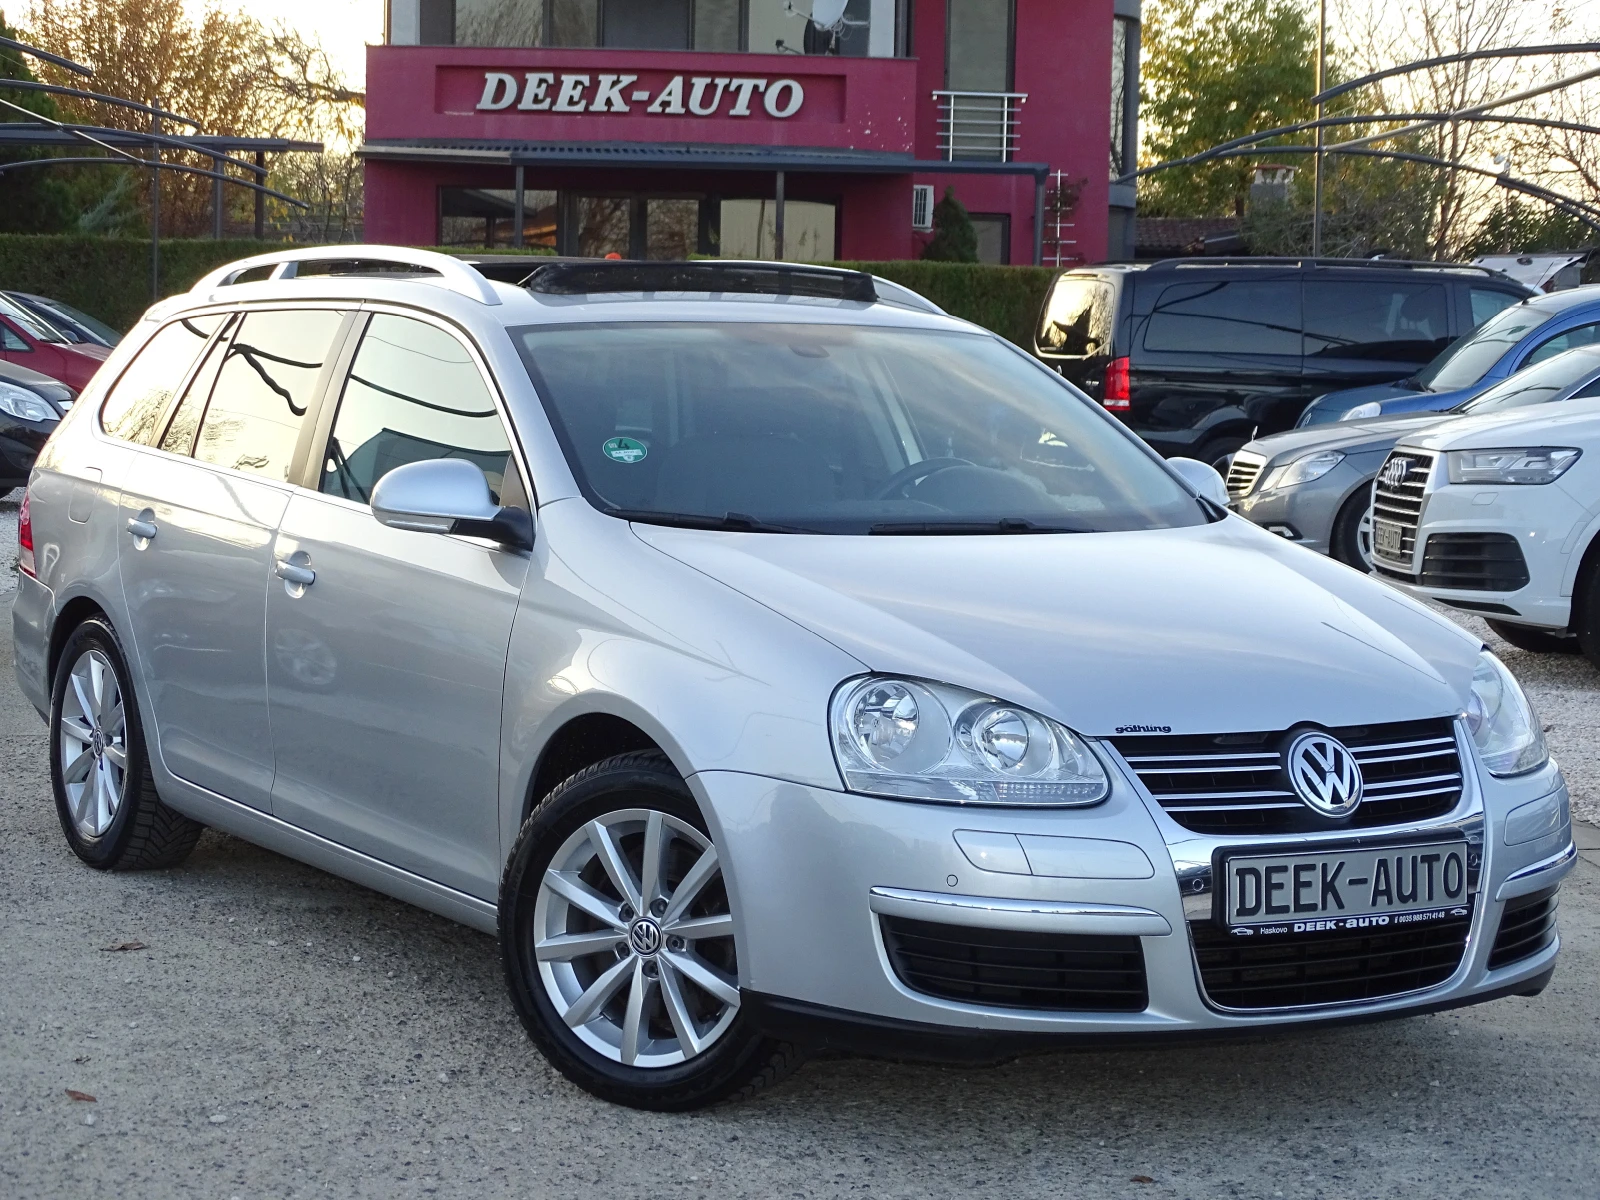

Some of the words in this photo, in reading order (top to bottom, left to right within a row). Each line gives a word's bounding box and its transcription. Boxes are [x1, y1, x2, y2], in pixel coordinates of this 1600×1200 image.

[475, 72, 805, 118] DEEK-AUTO
[1234, 851, 1464, 917] DEEK-AUTO
[1260, 926, 1288, 935] Haskovo
